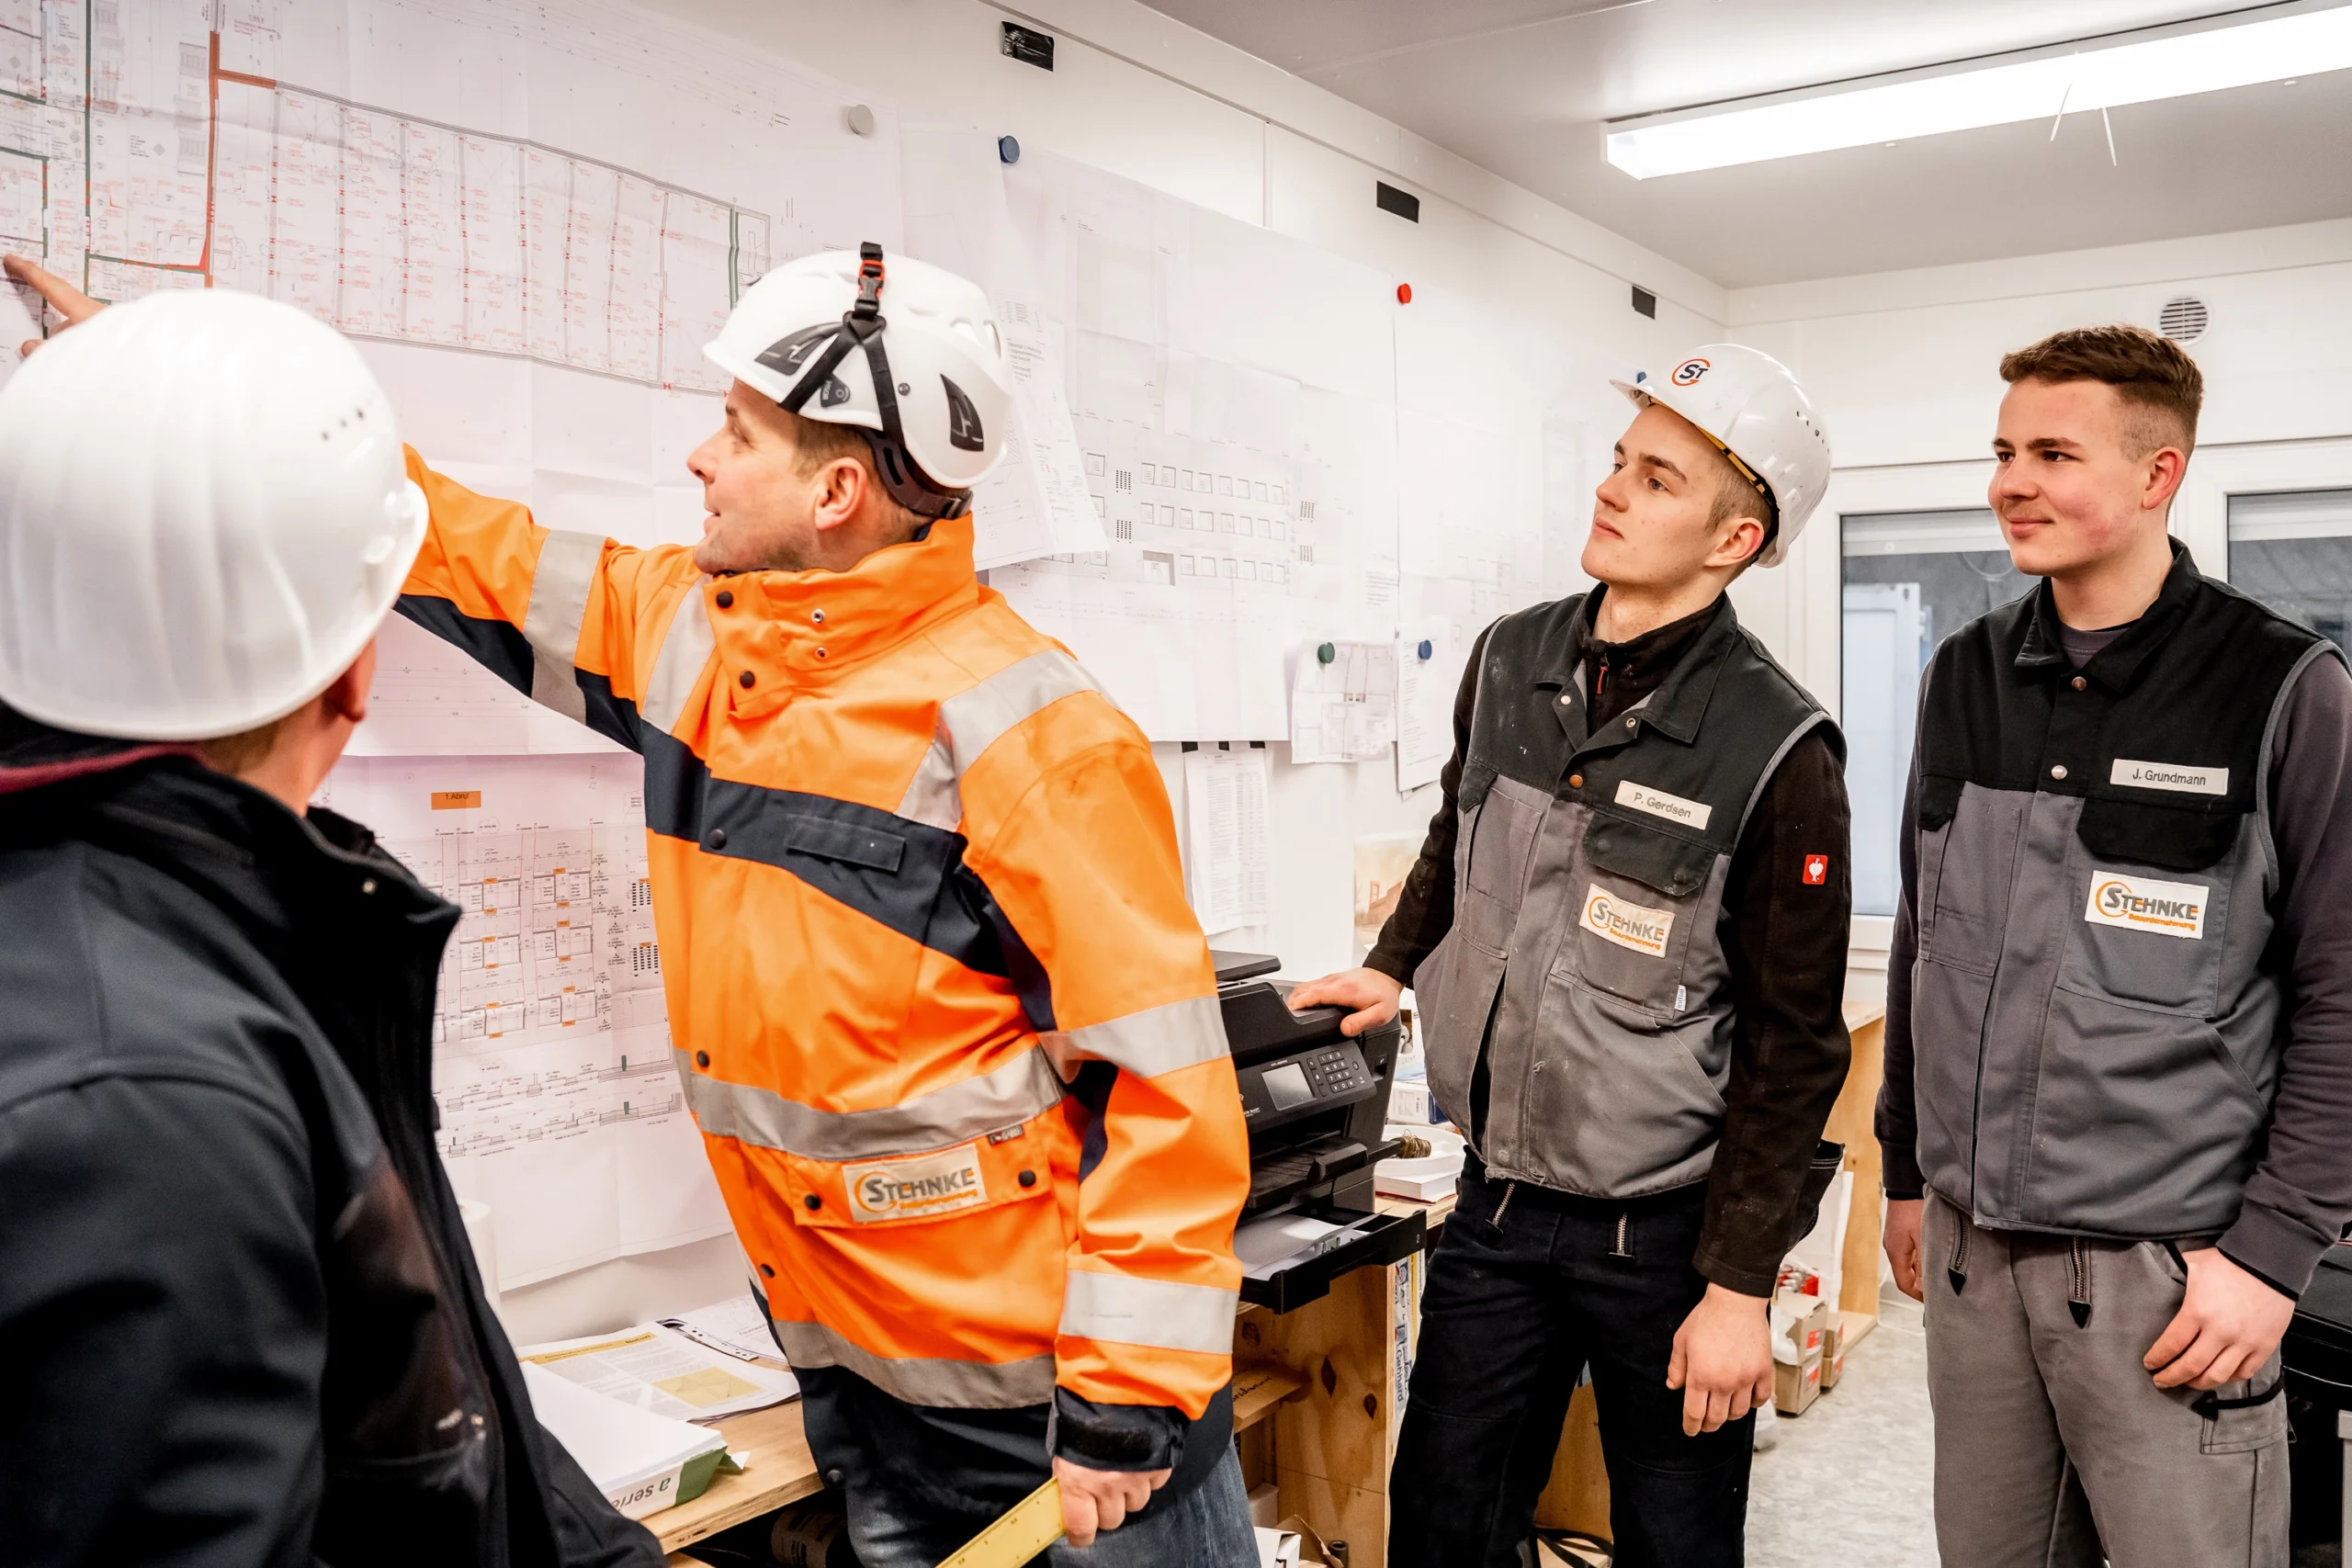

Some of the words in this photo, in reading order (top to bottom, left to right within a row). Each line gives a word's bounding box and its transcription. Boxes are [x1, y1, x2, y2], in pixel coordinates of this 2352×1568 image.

[1679, 364, 1709, 379] ST
[2132, 768, 2142, 780] J.
[2144, 770, 2207, 785] Grundmann
[1634, 792, 1644, 804] P.
[1646, 797, 1691, 818] Gerdsen
[2104, 886, 2199, 920] STEHNKE
[1593, 900, 1665, 942] STEHNKE
[865, 1167, 977, 1203] STEHNKE
[1396, 1349, 1405, 1403] Gebhard
[659, 1477, 672, 1492] a
